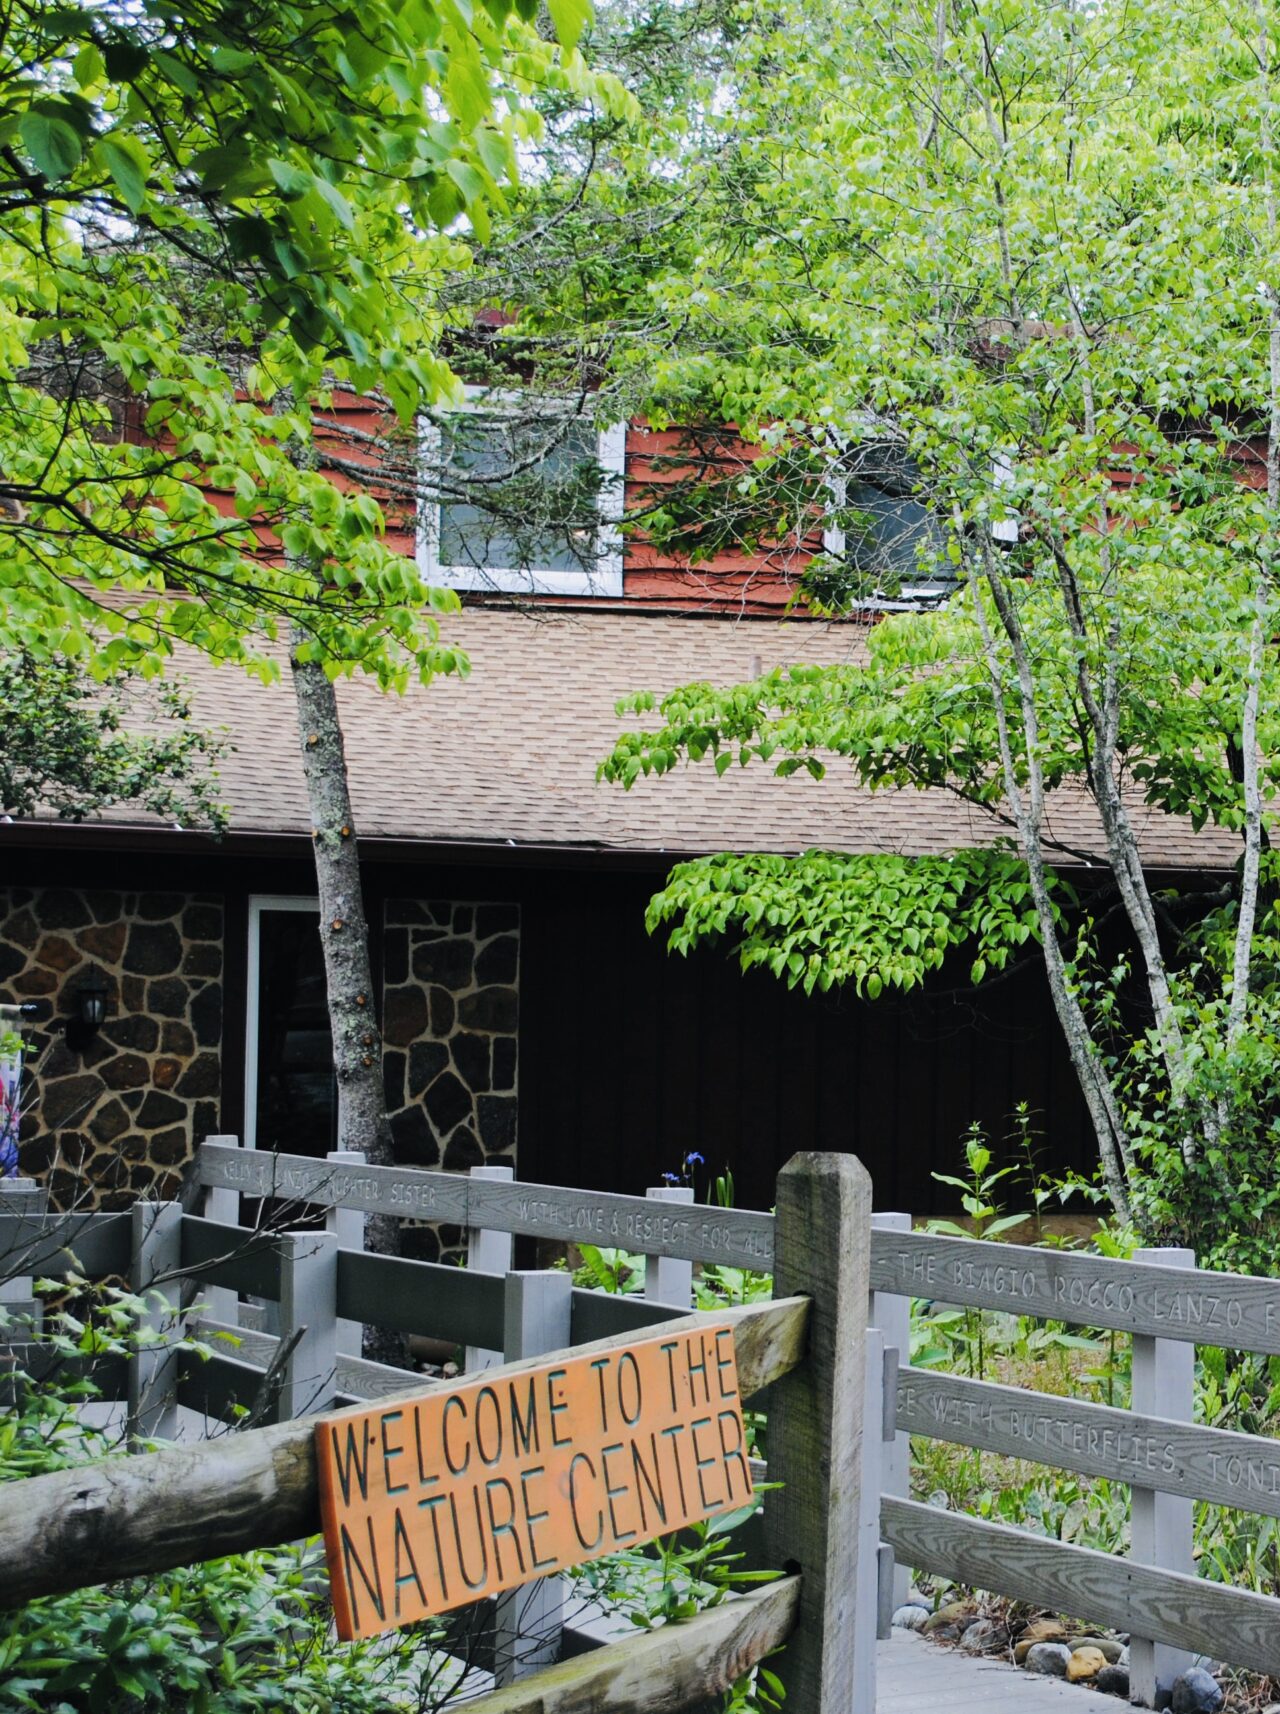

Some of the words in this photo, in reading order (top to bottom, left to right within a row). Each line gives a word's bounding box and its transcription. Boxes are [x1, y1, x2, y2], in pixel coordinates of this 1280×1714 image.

[390, 1183, 436, 1207] SISTER
[519, 1199, 558, 1225] WITH
[568, 1206, 603, 1233] LOVE
[626, 1214, 689, 1245] RESPECT
[700, 1223, 731, 1251] FOR
[743, 1230, 773, 1258] ALL
[898, 1252, 936, 1284] THE
[953, 1260, 1036, 1298] BIAGIO
[1054, 1274, 1134, 1313] ROCCO
[1153, 1287, 1243, 1329] LANZO
[331, 1368, 573, 1507] WELCOME
[591, 1351, 642, 1433] TO
[660, 1329, 738, 1413] THE
[933, 1391, 993, 1432] WITH
[1207, 1451, 1280, 1496] TONI
[339, 1466, 559, 1631] NATURE
[569, 1410, 753, 1551] CENTER
